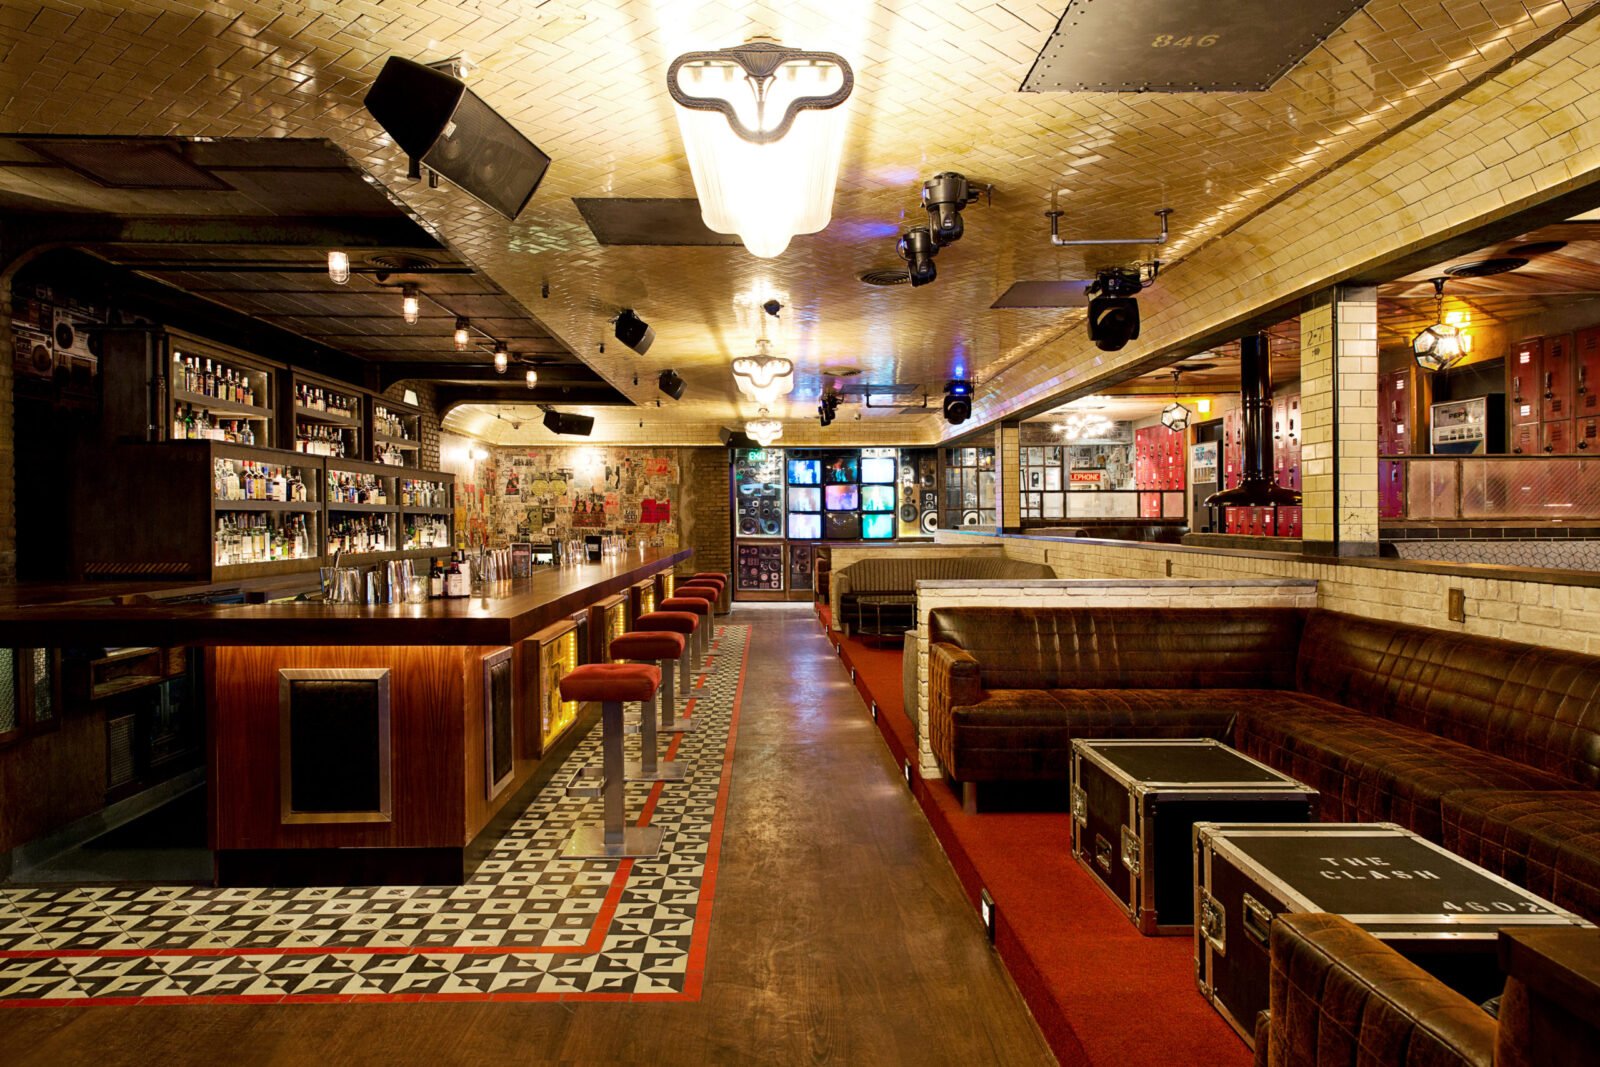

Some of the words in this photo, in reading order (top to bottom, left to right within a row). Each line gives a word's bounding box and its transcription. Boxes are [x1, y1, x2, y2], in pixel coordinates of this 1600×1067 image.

[1151, 34, 1220, 48] 846
[1070, 473, 1099, 481] LEPHONE
[1320, 857, 1391, 867] THE
[1319, 870, 1441, 880] CLASH
[1442, 900, 1549, 913] 4602
